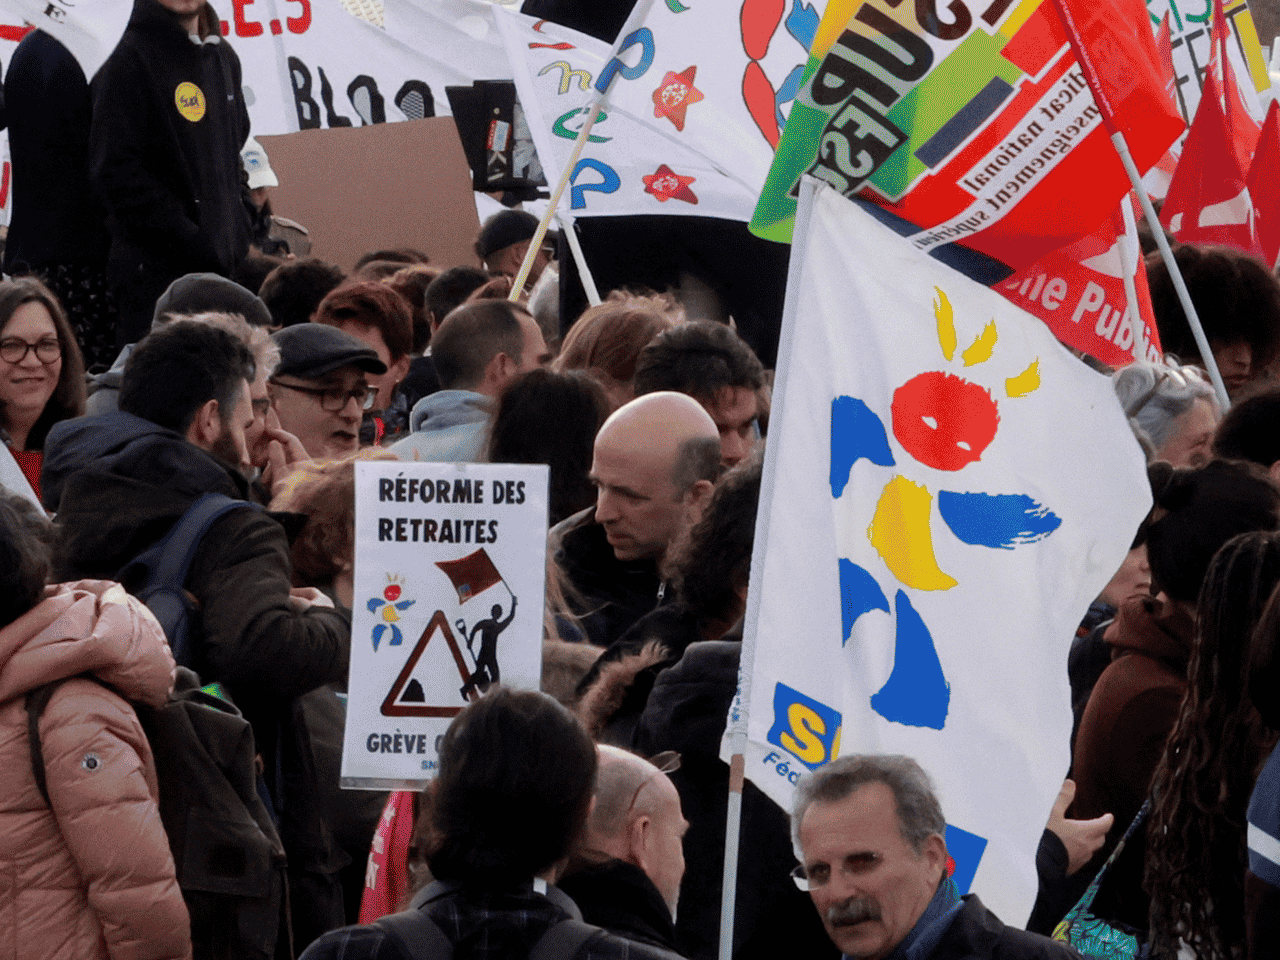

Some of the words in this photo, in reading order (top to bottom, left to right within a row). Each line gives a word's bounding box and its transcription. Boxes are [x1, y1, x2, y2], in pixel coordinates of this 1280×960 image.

[378, 472, 484, 504] RÉFORME
[492, 480, 526, 505] DES
[378, 518, 499, 544] RETRAITES
[366, 728, 428, 755] GRÈVE
